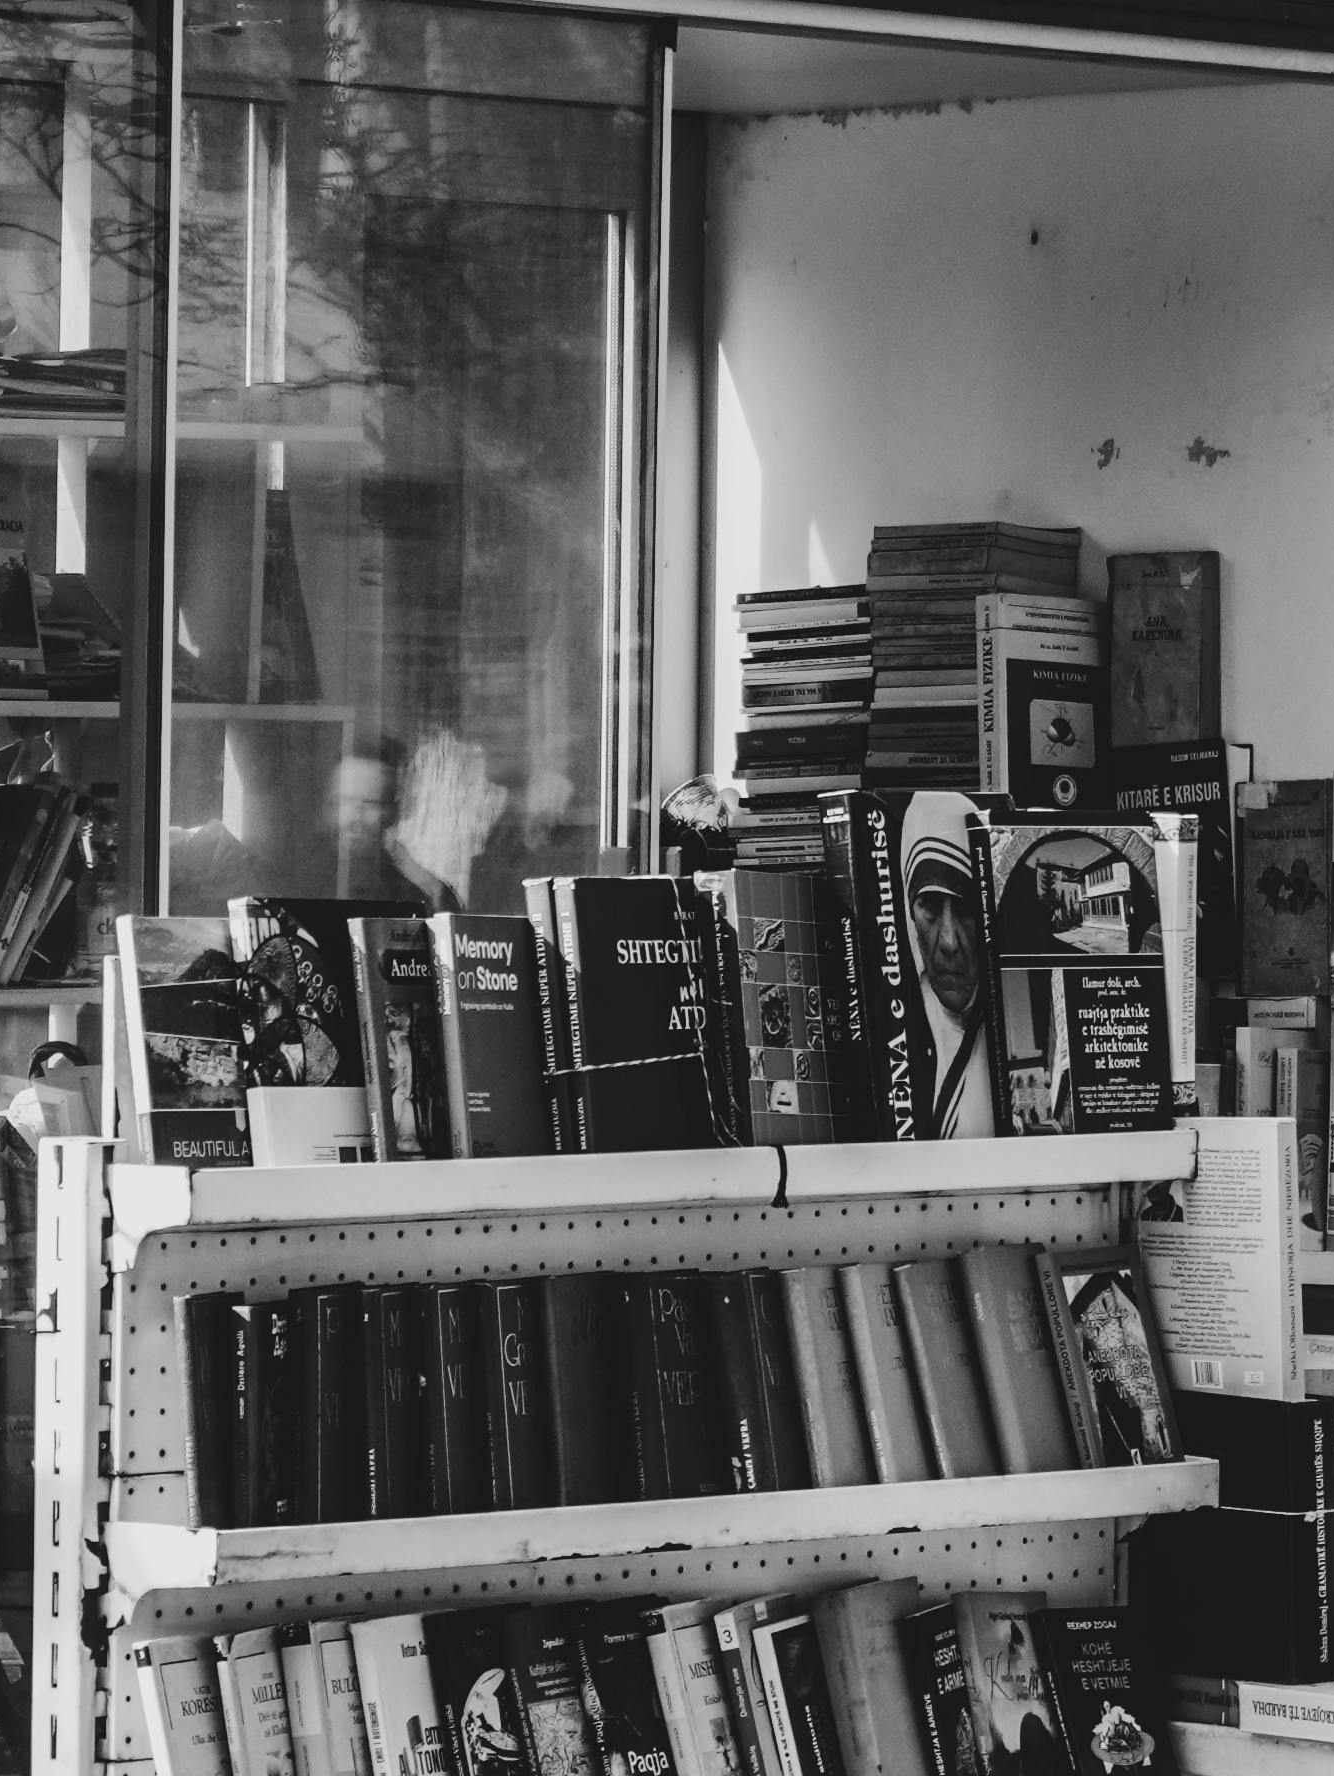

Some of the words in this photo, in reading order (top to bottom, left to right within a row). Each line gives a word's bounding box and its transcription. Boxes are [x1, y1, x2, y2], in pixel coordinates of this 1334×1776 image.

[982, 635, 993, 685] FIZIKE
[1033, 669, 1060, 680] KIMIA
[983, 688, 994, 733] KIMIA
[1116, 783, 1159, 811] KITARË
[1163, 787, 1171, 804] E
[1175, 782, 1221, 803] KRISUR
[867, 807, 902, 987] dashurisë
[455, 934, 513, 966] Memory
[458, 971, 475, 990] on
[476, 965, 518, 991] Stone
[890, 1000, 904, 1019] e
[1078, 1004, 1108, 1024] ruajtja
[1110, 1003, 1151, 1024] praktike
[1082, 1025, 1088, 1036] e
[1090, 1020, 1149, 1040] trashëgimisë
[1085, 1037, 1149, 1053] arkitektonike
[1095, 1056, 1106, 1069] në
[1108, 1054, 1141, 1069] kosovë
[889, 1029, 917, 1141] NËNA
[173, 1140, 240, 1159] BEAUTIFUL
[1046, 1281, 1067, 1335] POPULLORE
[723, 1629, 733, 1644] 3
[1082, 1640, 1112, 1655] KOHË
[1073, 1658, 1132, 1674] HESHTJEJE
[1082, 1677, 1089, 1690] E
[1092, 1675, 1131, 1690] VETMIE
[1252, 1701, 1287, 1717] BARDHA
[627, 1746, 669, 1776] Paqja
